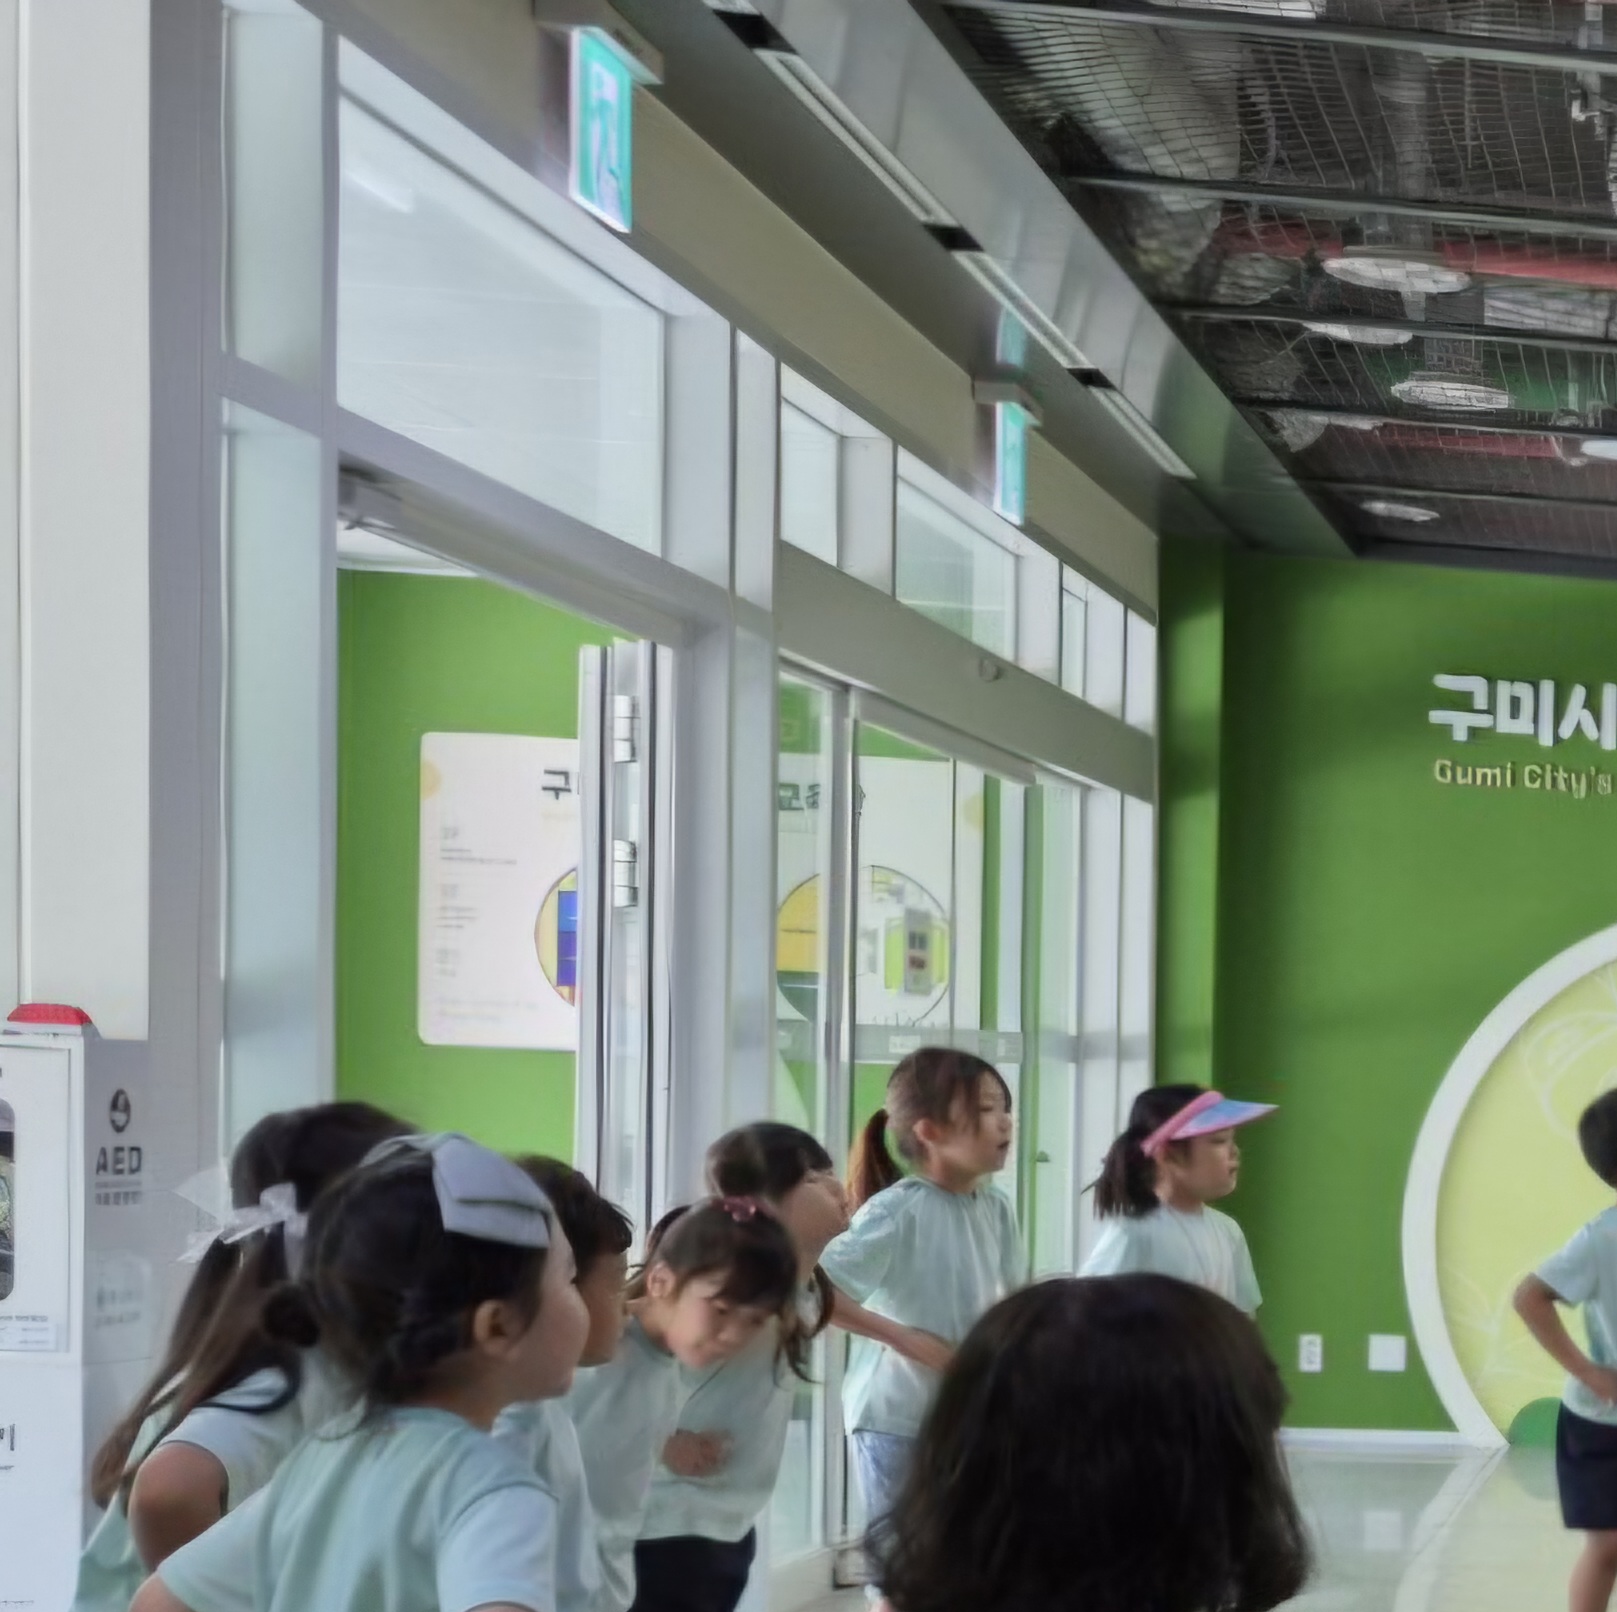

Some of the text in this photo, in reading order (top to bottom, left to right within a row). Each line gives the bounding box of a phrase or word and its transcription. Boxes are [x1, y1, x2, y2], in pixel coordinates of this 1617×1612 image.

[1434, 758, 1512, 788] Gumi
[1523, 763, 1613, 799] City's
[95, 1146, 143, 1176] AED
